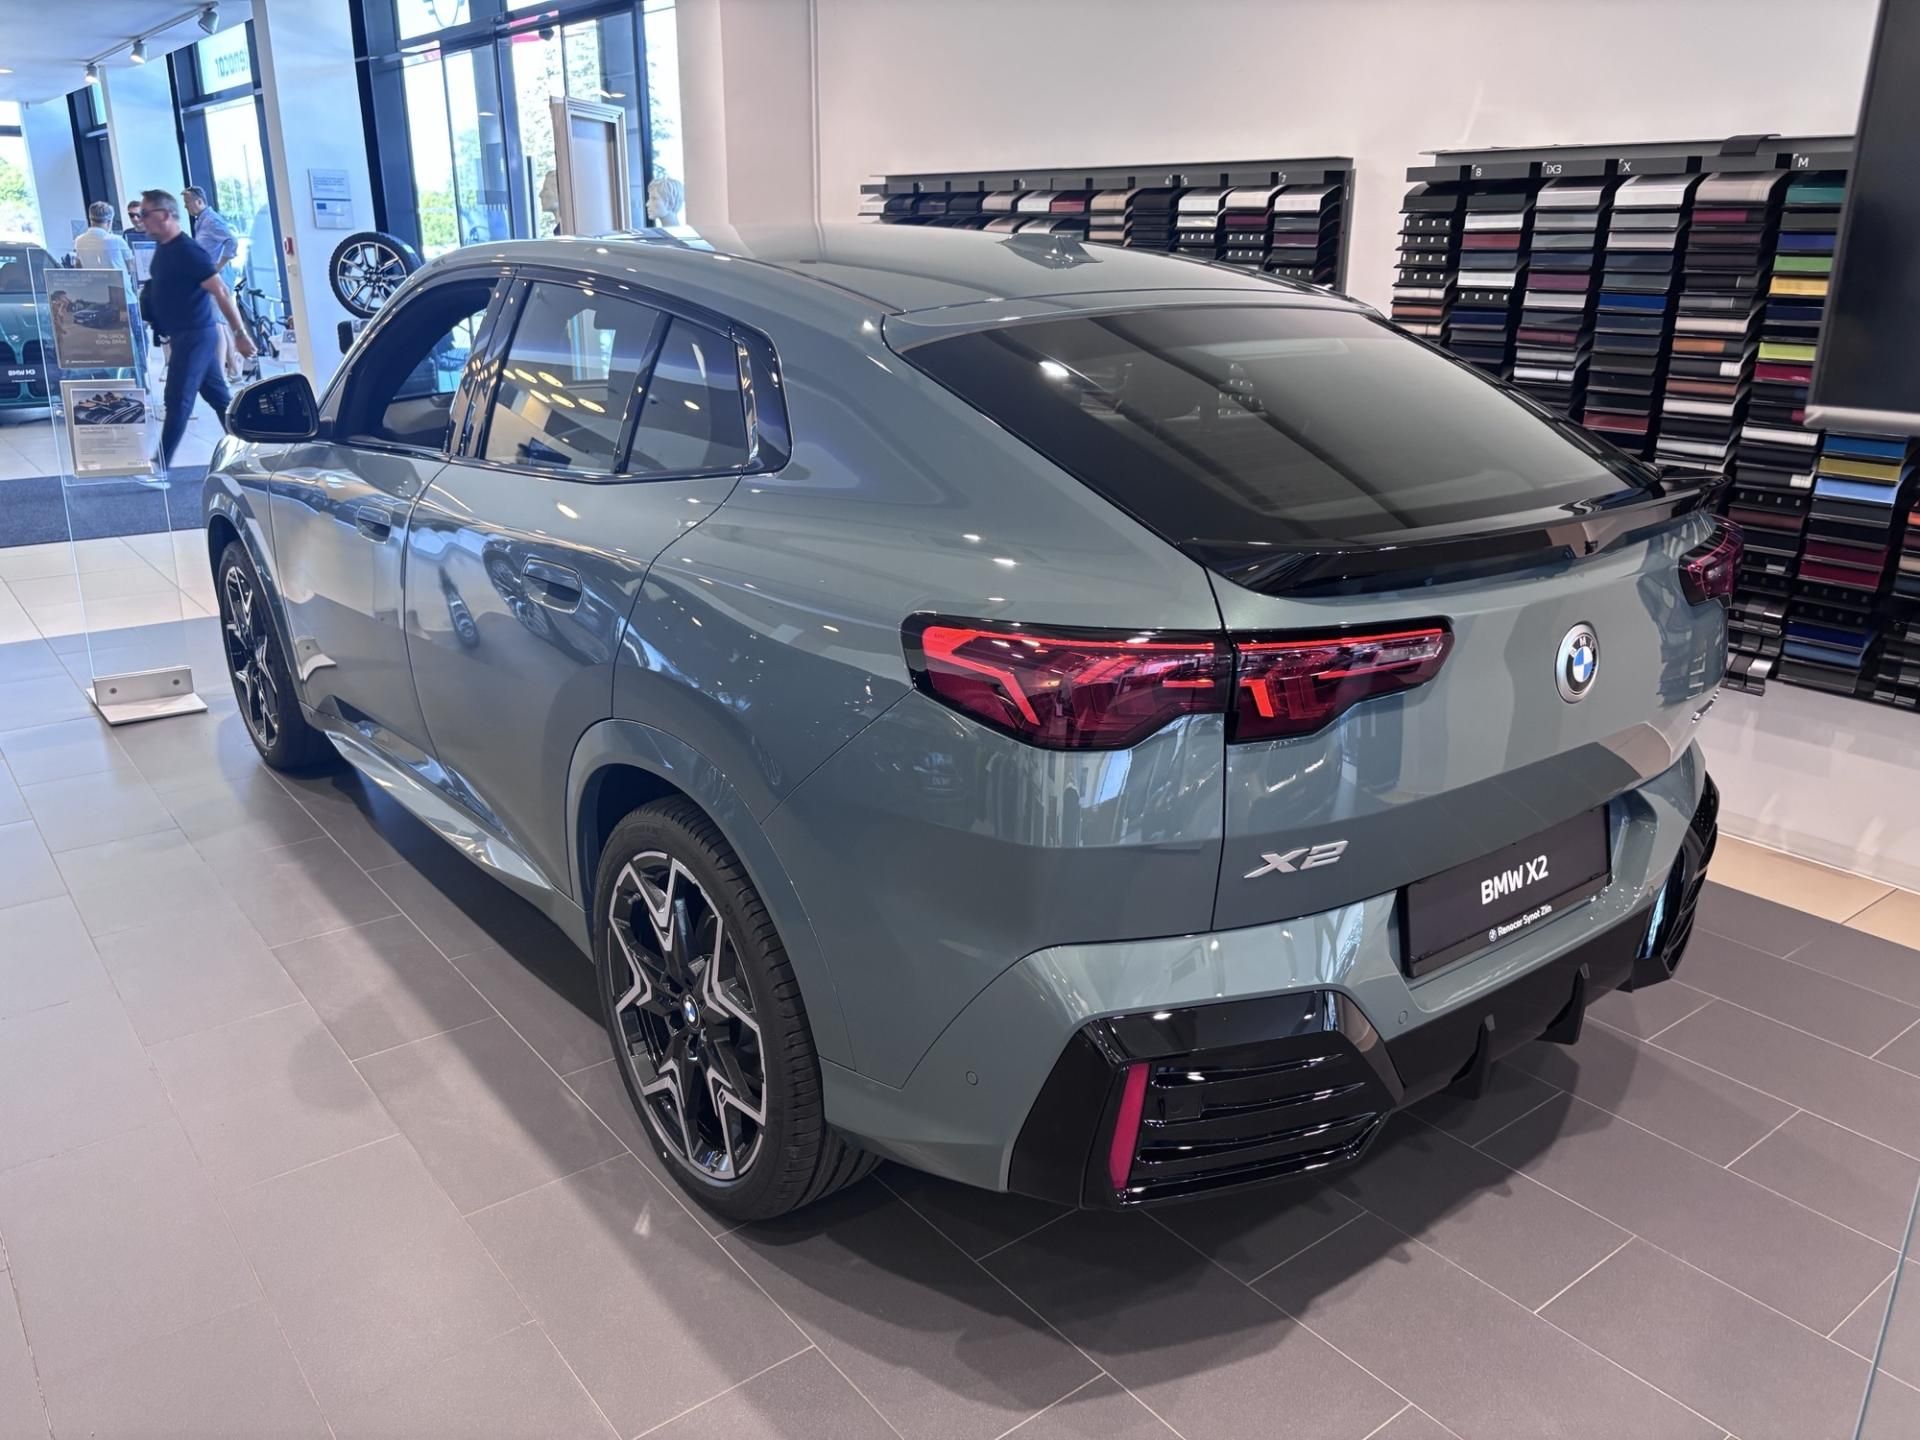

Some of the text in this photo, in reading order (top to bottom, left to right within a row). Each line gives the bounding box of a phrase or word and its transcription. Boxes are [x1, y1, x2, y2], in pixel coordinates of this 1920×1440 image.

[1622, 161, 1632, 172] X
[1798, 157, 1809, 168] M
[1475, 167, 1482, 177] 8
[1546, 164, 1562, 174] iX3
[1243, 840, 1349, 879] X2
[1480, 855, 1549, 905] BMW X2
[1497, 919, 1523, 937] Renocar
[1522, 909, 1541, 925] Synot
